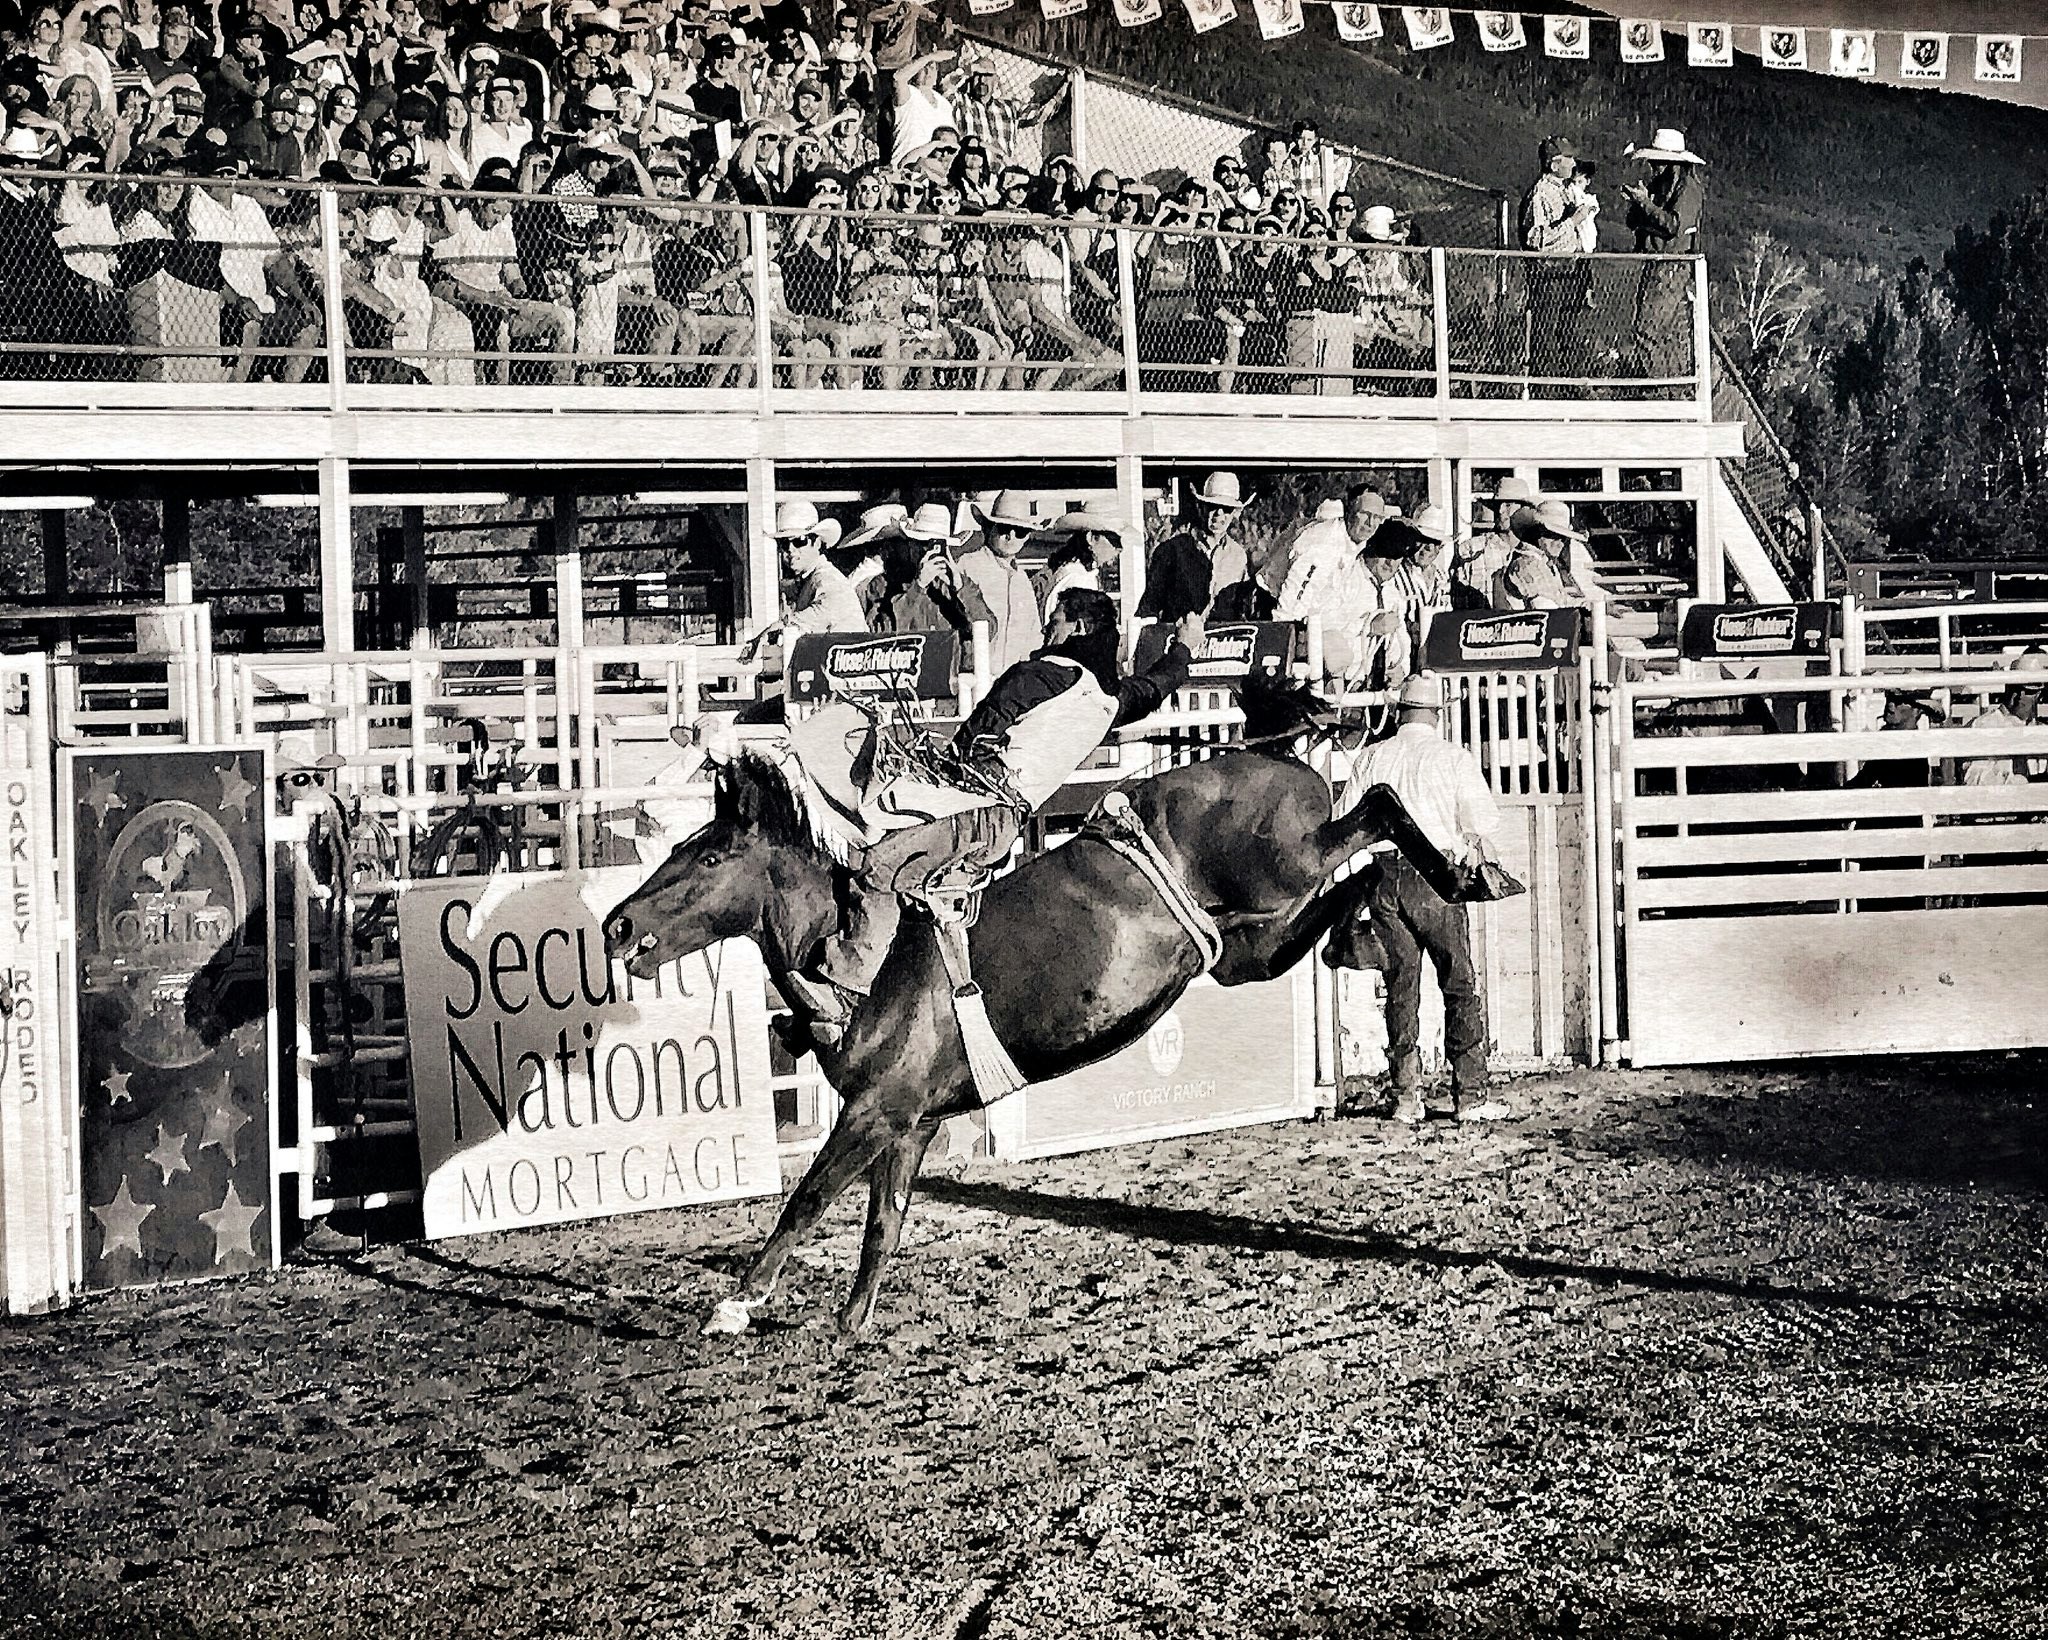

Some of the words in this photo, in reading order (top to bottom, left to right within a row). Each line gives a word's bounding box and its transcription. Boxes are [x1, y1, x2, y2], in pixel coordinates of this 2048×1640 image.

[1467, 623, 1494, 644] Hose
[1502, 621, 1540, 642] Rubber
[833, 649, 863, 673] Hose
[870, 645, 916, 671] Rubber
[7, 781, 30, 944] OAKLEY
[1152, 1027, 1179, 1057] VR
[446, 990, 743, 1143] National
[1112, 1085, 1172, 1111] VICTORY
[1173, 1079, 1217, 1102] RANCH
[461, 1133, 751, 1224] MORTGAGE
